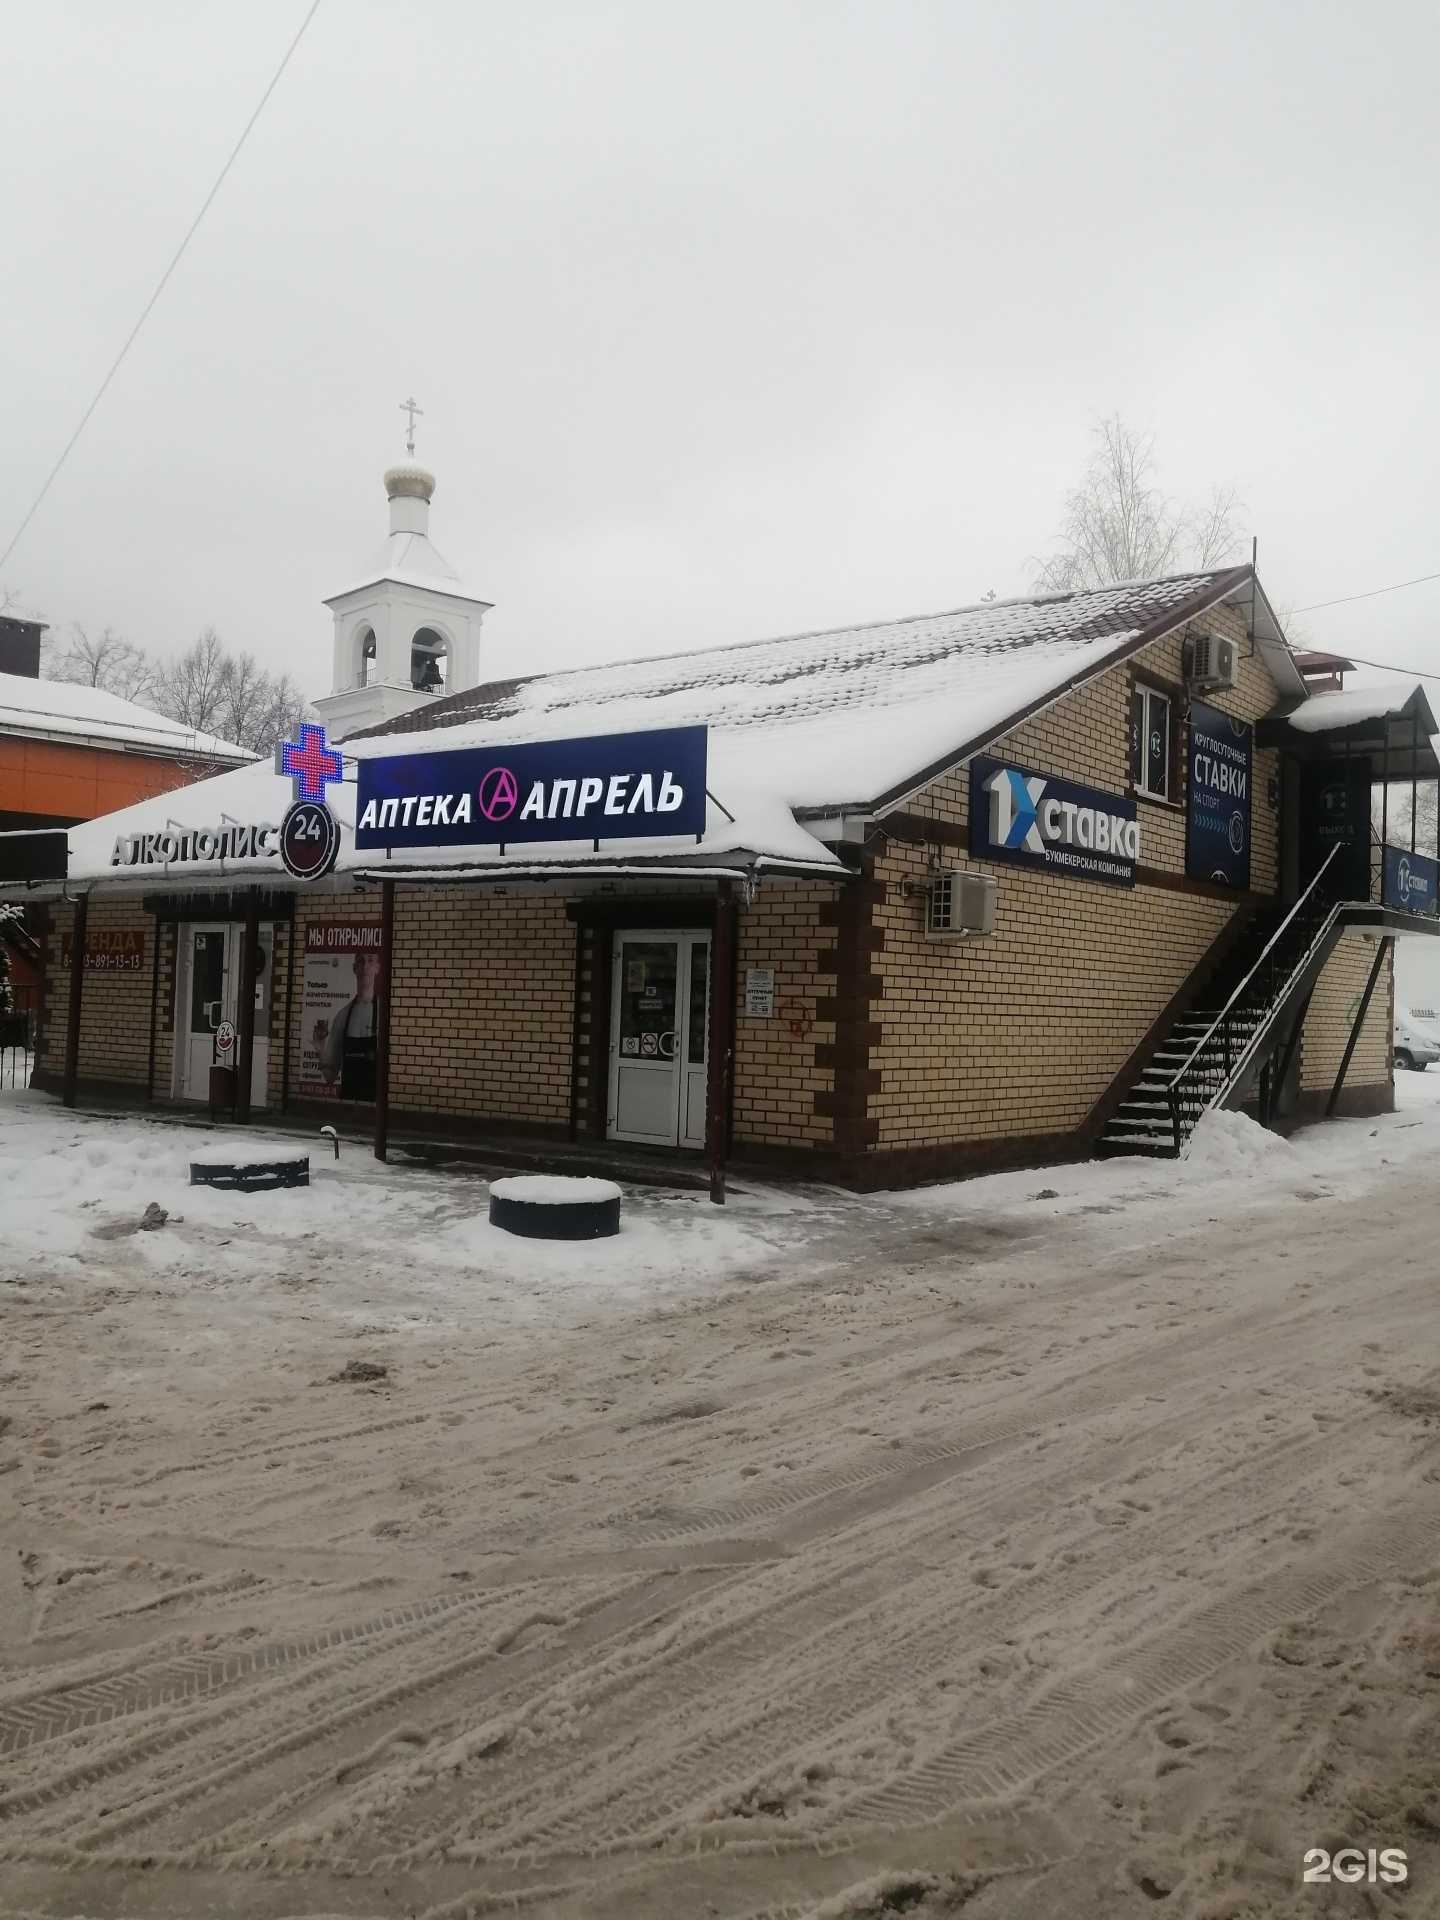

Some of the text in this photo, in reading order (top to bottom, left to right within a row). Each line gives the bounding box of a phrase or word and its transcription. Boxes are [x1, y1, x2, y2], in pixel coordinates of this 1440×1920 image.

[1194, 731, 1247, 765] КРУГЛОСУТОЧНЫЕ
[1194, 753, 1247, 800] СТАВКИ
[359, 793, 472, 829] АПТЕКА
[519, 771, 685, 820] АПРЕЛЬ
[1193, 791, 1220, 810] НА СПОРТ
[111, 814, 321, 866] АЛКОПОЛИС 24
[1045, 848, 1132, 878] БУКМЕКЕРСКАЯ КОМПАНИЯ
[308, 928, 325, 946] МЫ
